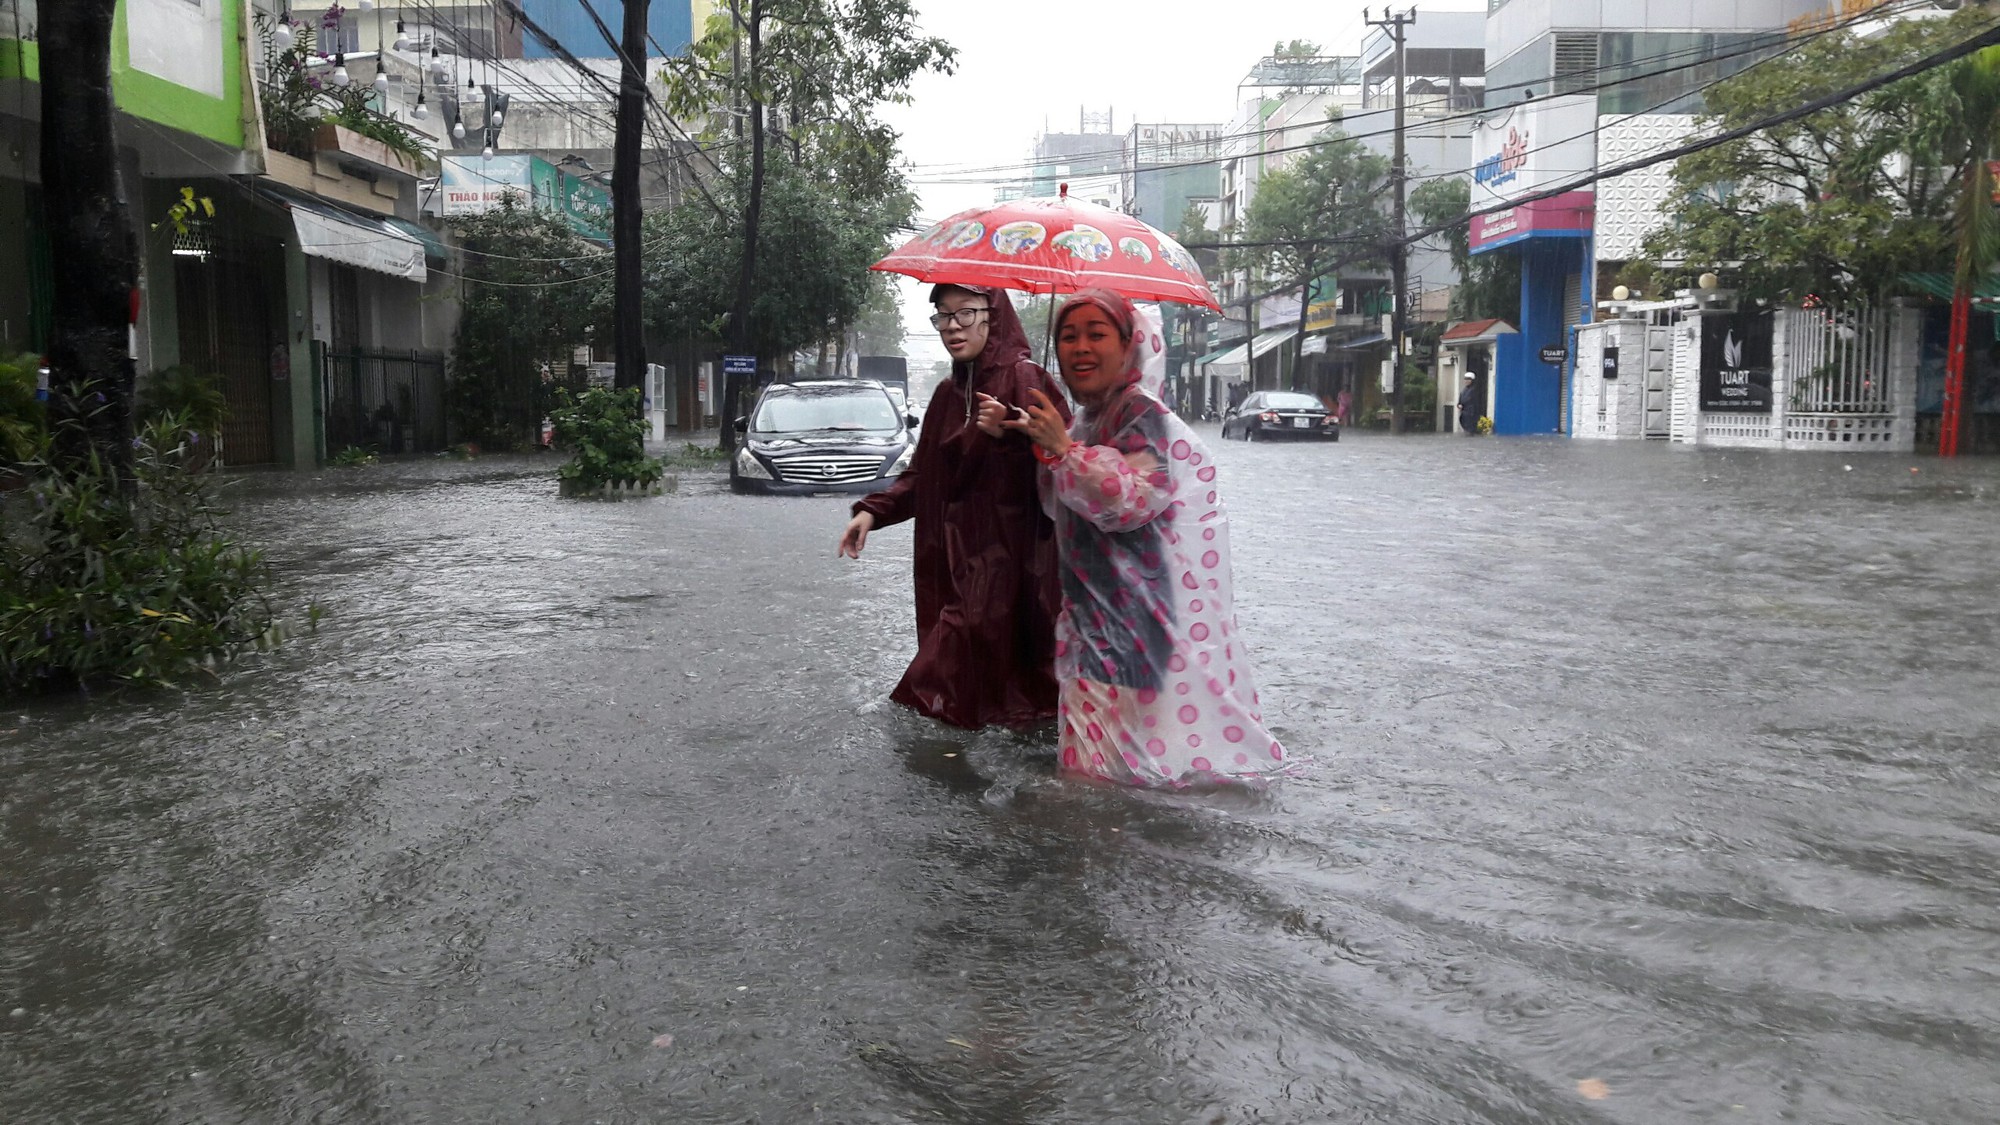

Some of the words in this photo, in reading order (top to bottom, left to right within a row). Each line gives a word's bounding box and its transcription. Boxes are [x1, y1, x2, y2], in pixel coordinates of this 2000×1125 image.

[1161, 130, 1200, 143] NAM
[1543, 349, 1565, 357] TUART
[1719, 370, 1750, 385] TUART
[1721, 387, 1749, 397] WEDDING
